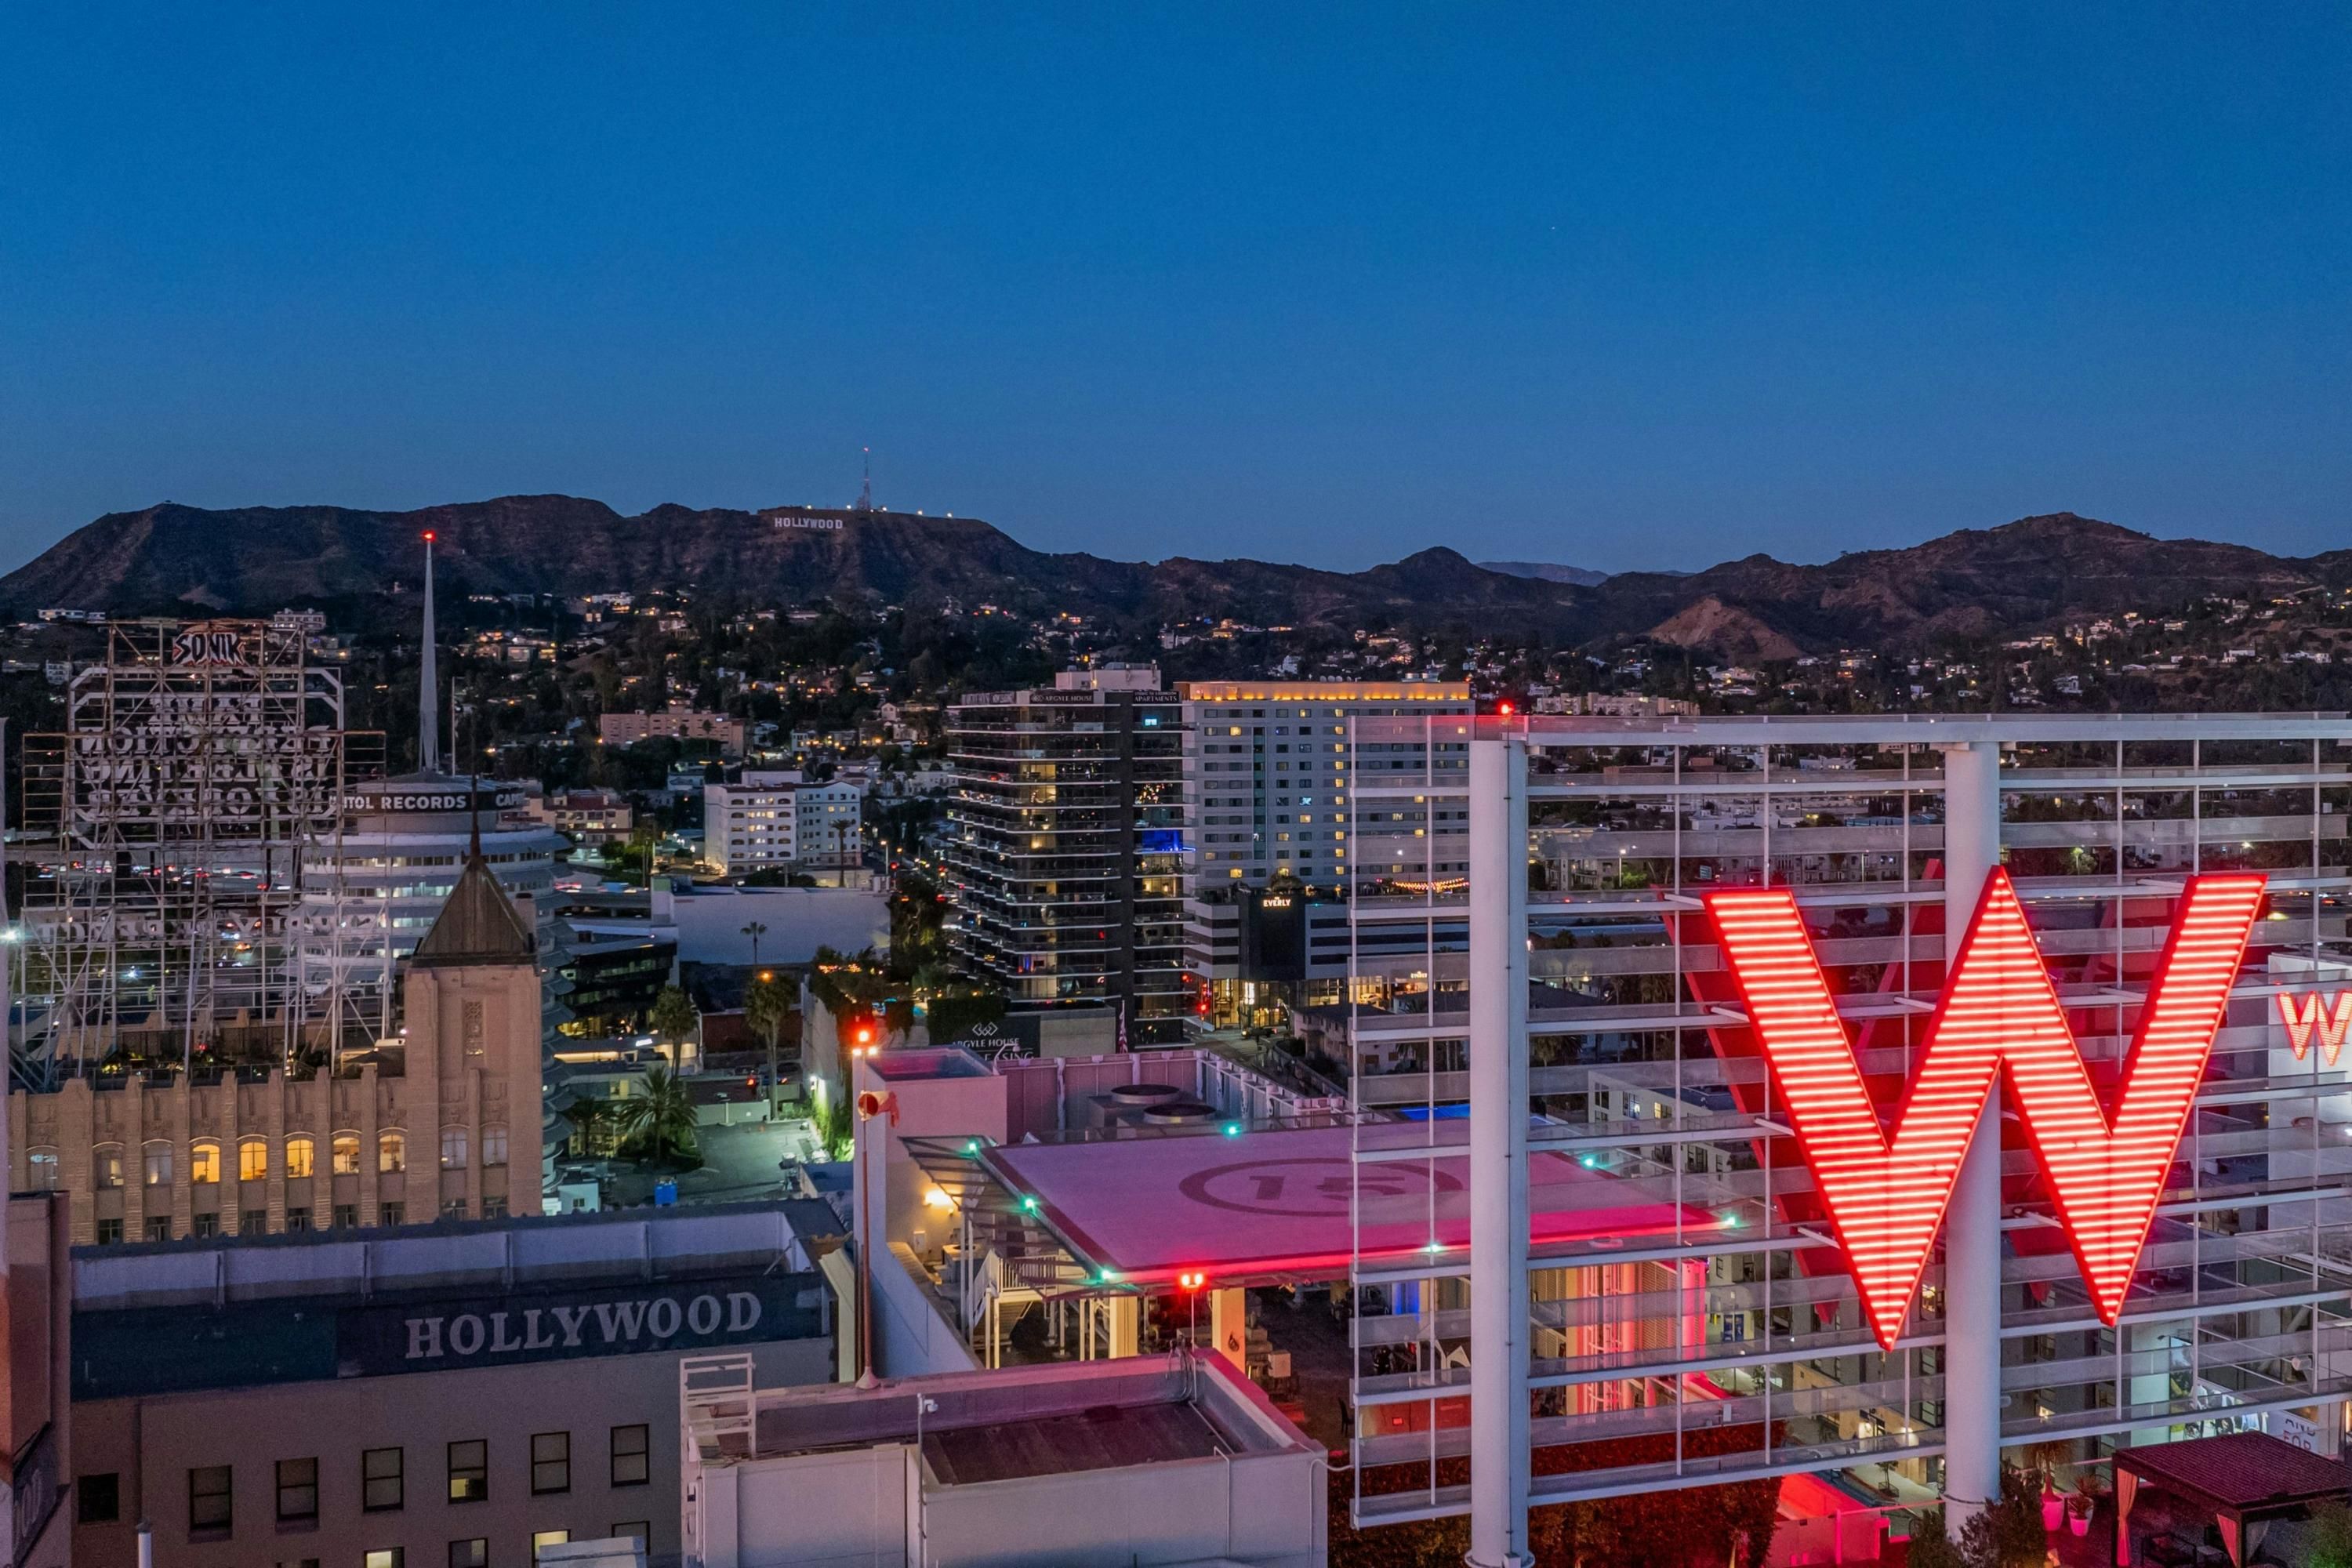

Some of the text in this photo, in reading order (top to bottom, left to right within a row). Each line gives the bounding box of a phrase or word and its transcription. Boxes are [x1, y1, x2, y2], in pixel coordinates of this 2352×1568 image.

[774, 517, 843, 529] HOLLYWOOD
[173, 632, 245, 665] SONIK
[381, 795, 467, 809] RECORDS
[1263, 898, 1290, 907] EVERLY
[2275, 991, 2352, 1066] W
[953, 1037, 1019, 1048] RGYLE HOUSE
[1700, 865, 2269, 1353] W
[404, 1291, 762, 1359] HOLLYWOOD
